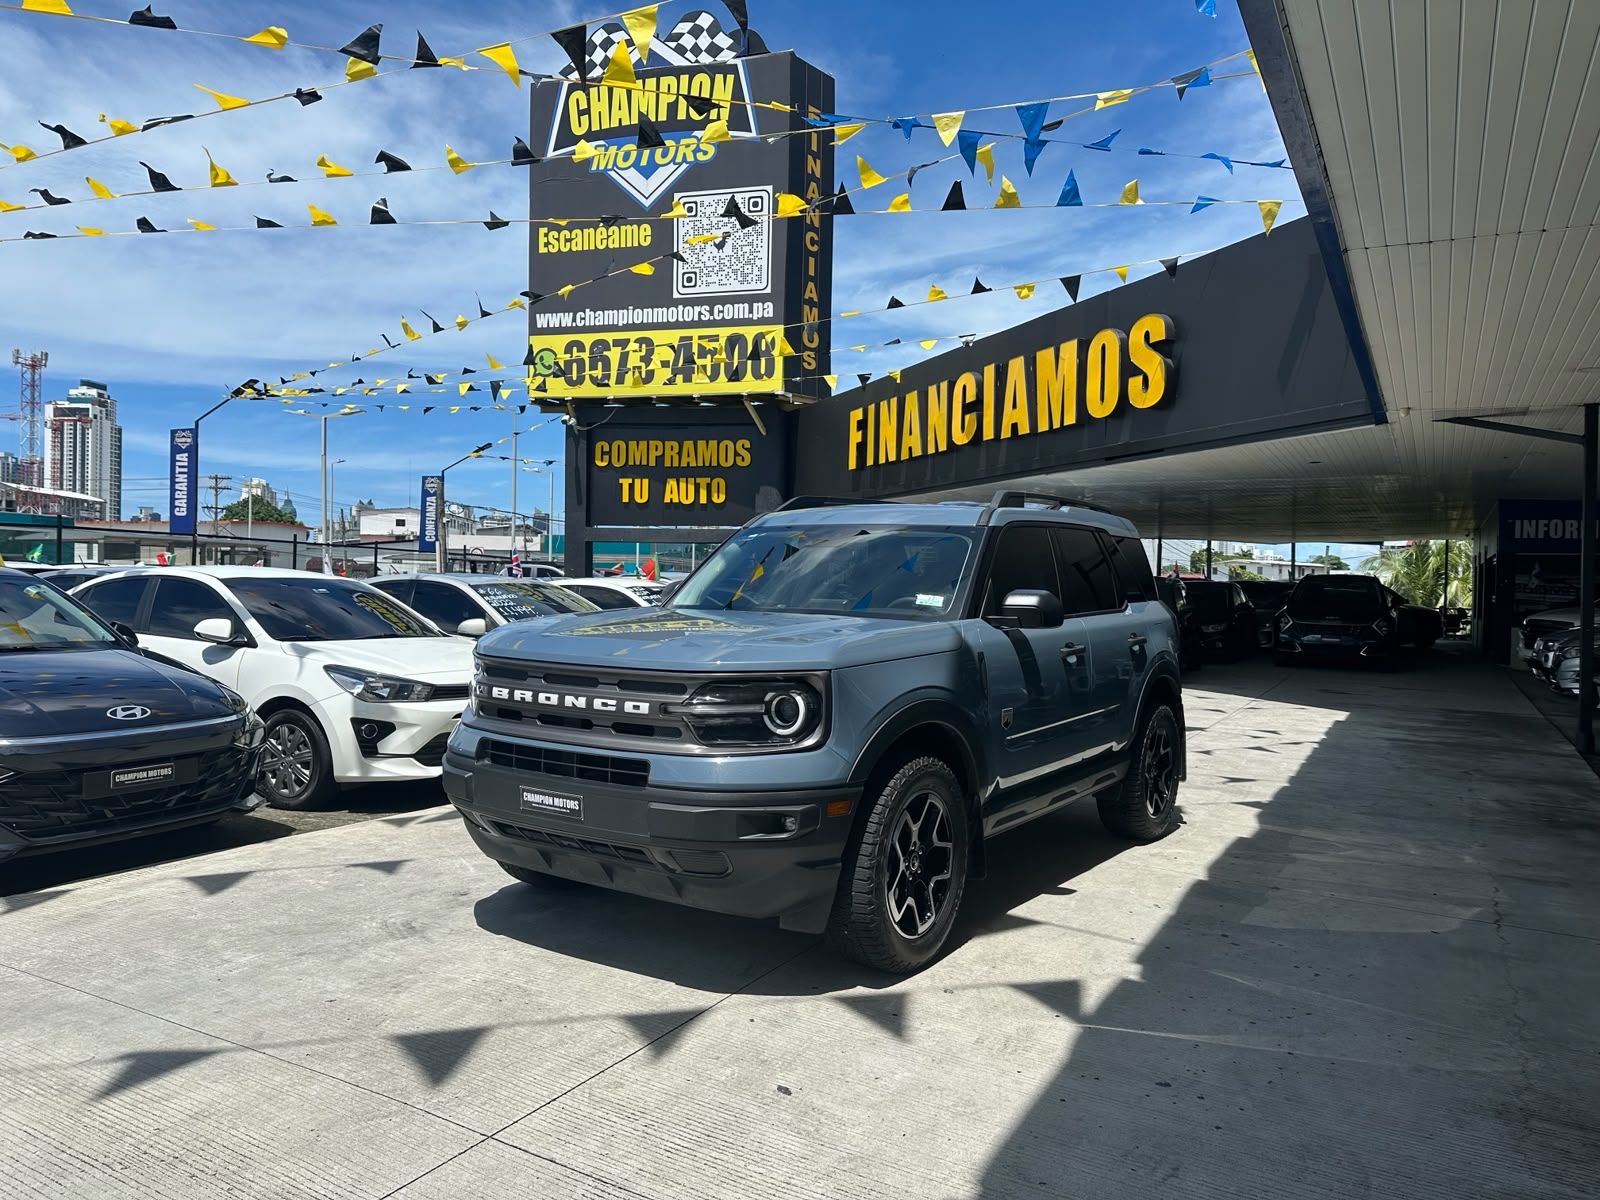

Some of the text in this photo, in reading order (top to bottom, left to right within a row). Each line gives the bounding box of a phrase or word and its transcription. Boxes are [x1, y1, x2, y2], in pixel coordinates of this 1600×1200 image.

[568, 73, 734, 135] CHAMPION
[591, 137, 715, 171] MOTORS
[538, 223, 652, 254] Escanéame
[802, 104, 821, 370] FINANCIAMOS
[536, 301, 773, 328] www.championmotors.com.pa
[848, 313, 1170, 470] FINANCIAMOS
[594, 439, 751, 467] COMPRAMOS
[174, 452, 188, 517] GARANTIA
[619, 477, 726, 505] TU AUTO
[425, 496, 437, 542] CONFIANZA
[492, 686, 649, 714] BRONCO
[115, 771, 147, 782] CHAMPION
[148, 767, 172, 778] MOTORS
[523, 792, 553, 805] CHAMPION
[554, 797, 579, 810] MOTORS
